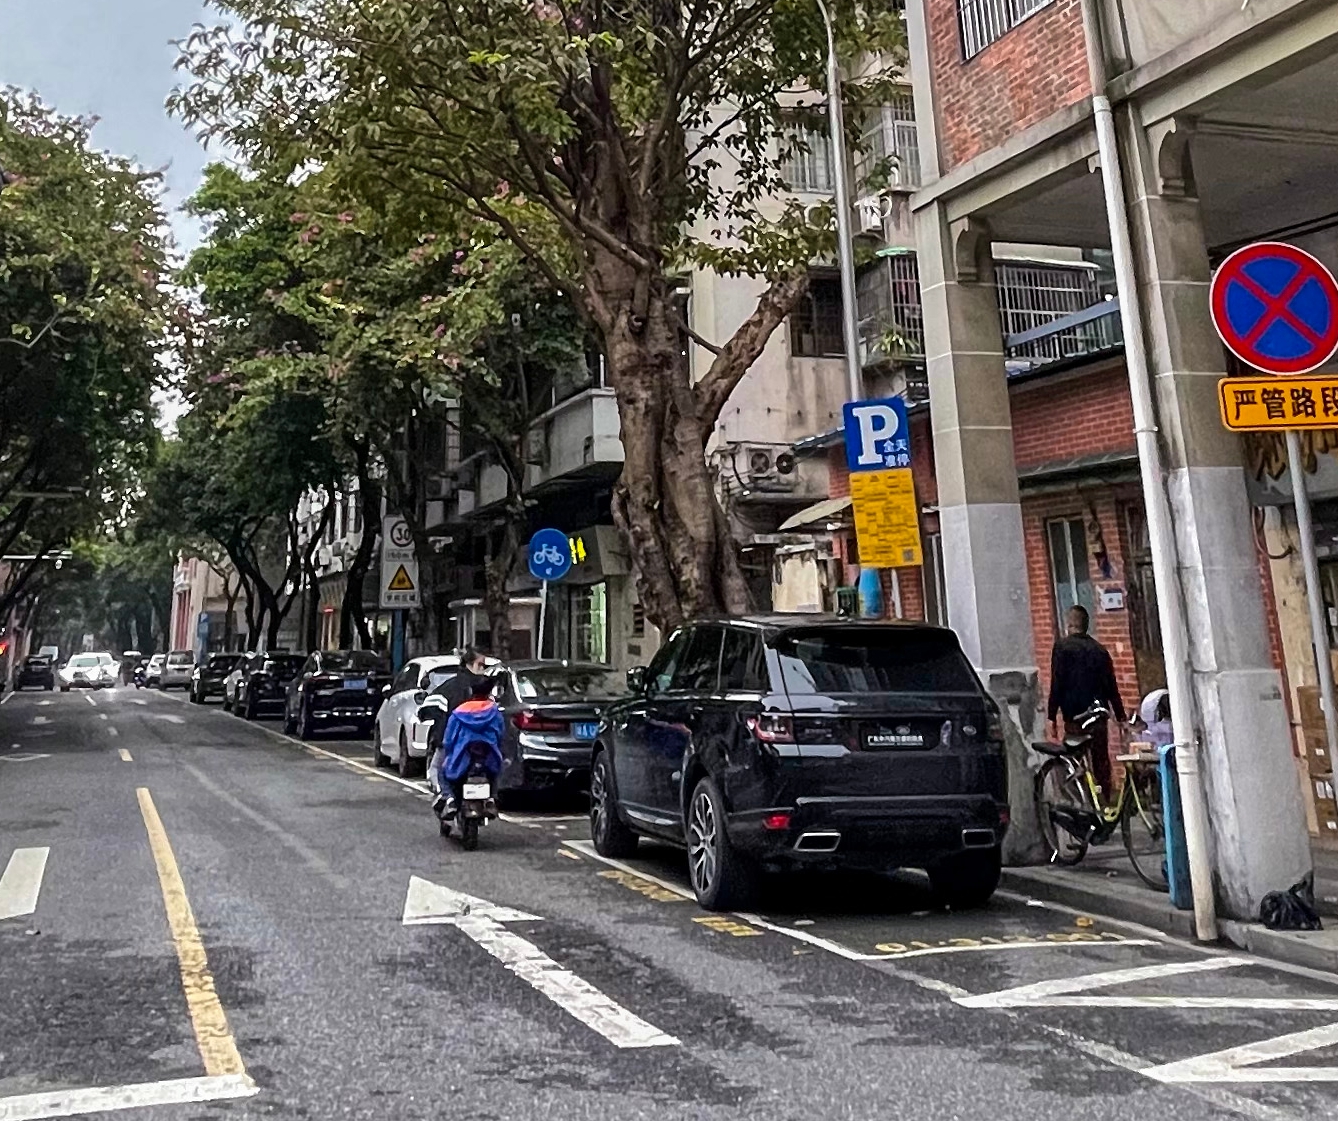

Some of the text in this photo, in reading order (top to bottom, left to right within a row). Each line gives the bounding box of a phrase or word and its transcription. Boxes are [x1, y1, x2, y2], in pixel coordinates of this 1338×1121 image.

[852, 405, 899, 465] P
[883, 439, 908, 453] 全天
[395, 527, 411, 541] 30
